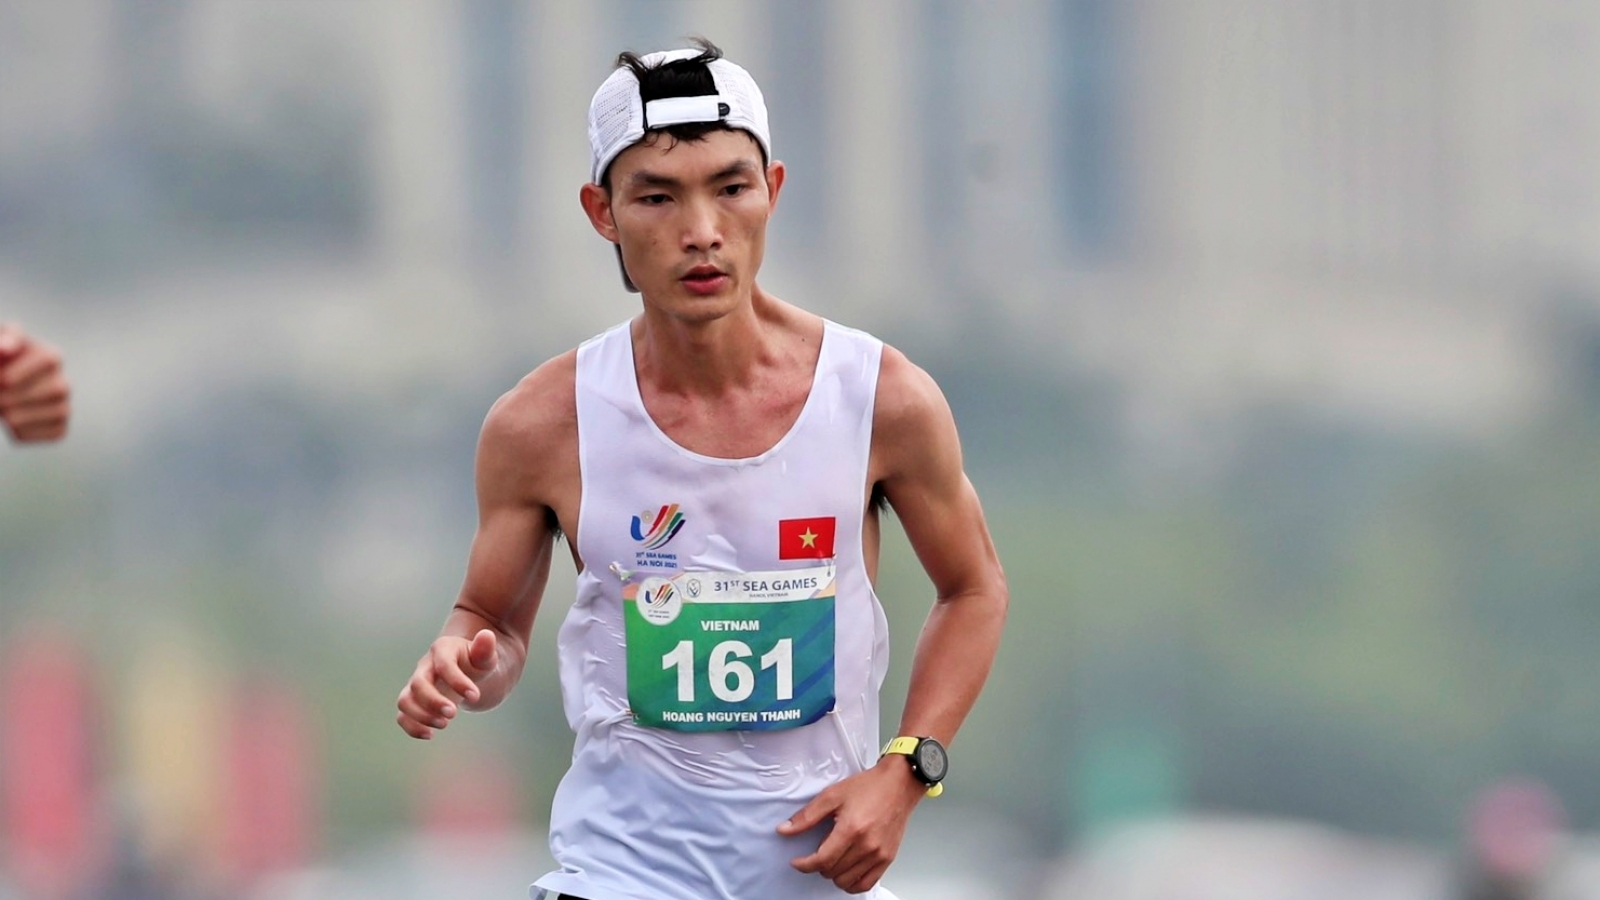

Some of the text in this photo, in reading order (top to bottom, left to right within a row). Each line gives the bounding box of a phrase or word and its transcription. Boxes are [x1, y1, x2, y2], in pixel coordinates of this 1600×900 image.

[714, 577, 817, 591] 31ST SEA GAMES
[701, 620, 760, 631] VIETNAM
[662, 638, 793, 702] 161
[663, 709, 800, 722] HOANG NGUYEN THANH
